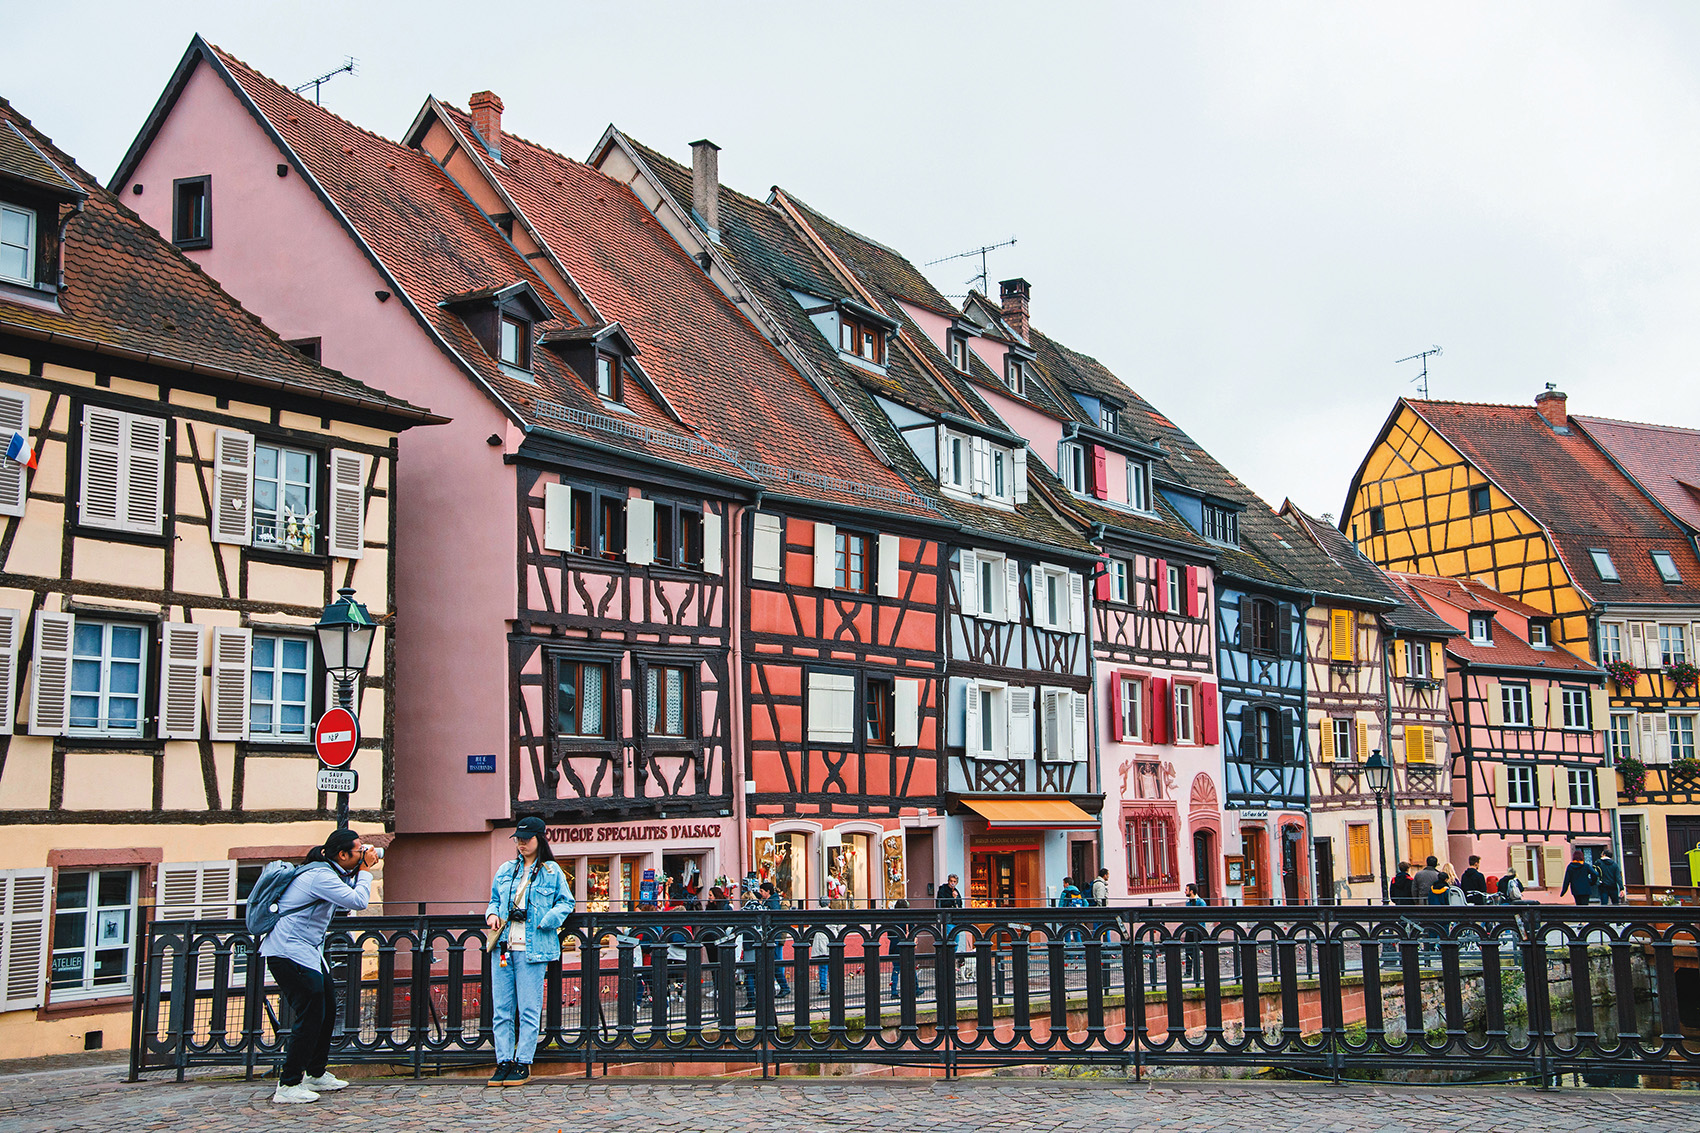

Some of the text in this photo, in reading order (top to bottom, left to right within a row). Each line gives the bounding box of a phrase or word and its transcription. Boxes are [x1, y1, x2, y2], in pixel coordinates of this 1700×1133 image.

[545, 825, 721, 842] OUTIQUE SPECIALITES D'ALSACE
[52, 957, 82, 968] ATELIER
